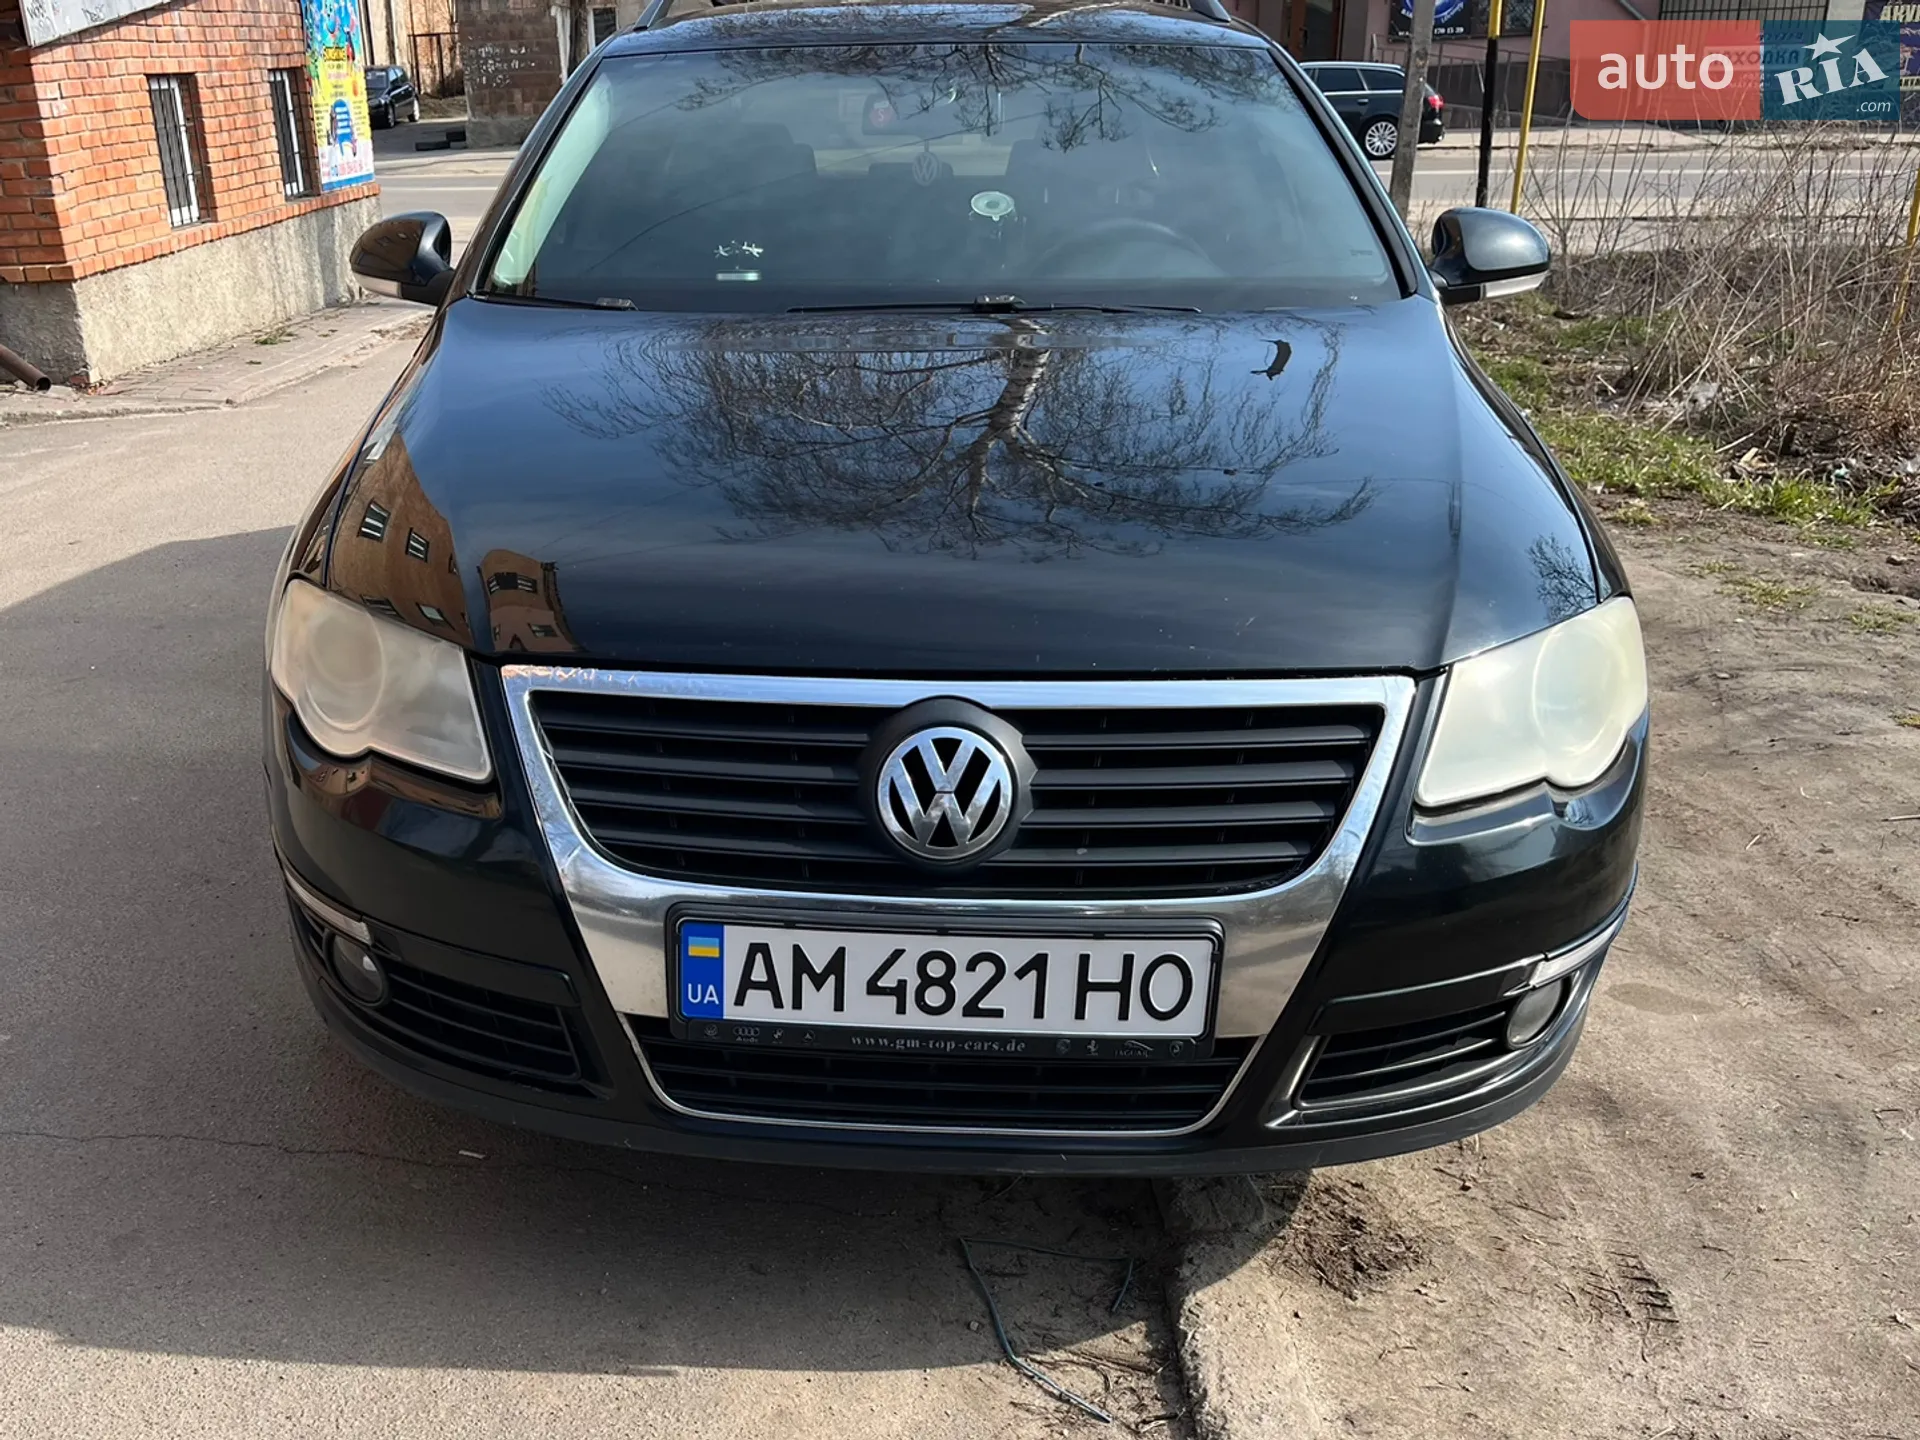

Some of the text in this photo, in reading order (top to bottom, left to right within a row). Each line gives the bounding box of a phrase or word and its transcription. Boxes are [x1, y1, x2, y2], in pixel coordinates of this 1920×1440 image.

[733, 942, 1194, 1021] AM 4821 HO
[687, 983, 720, 1006] UA
[851, 1035, 1026, 1053] www.gm-top-cars.de
